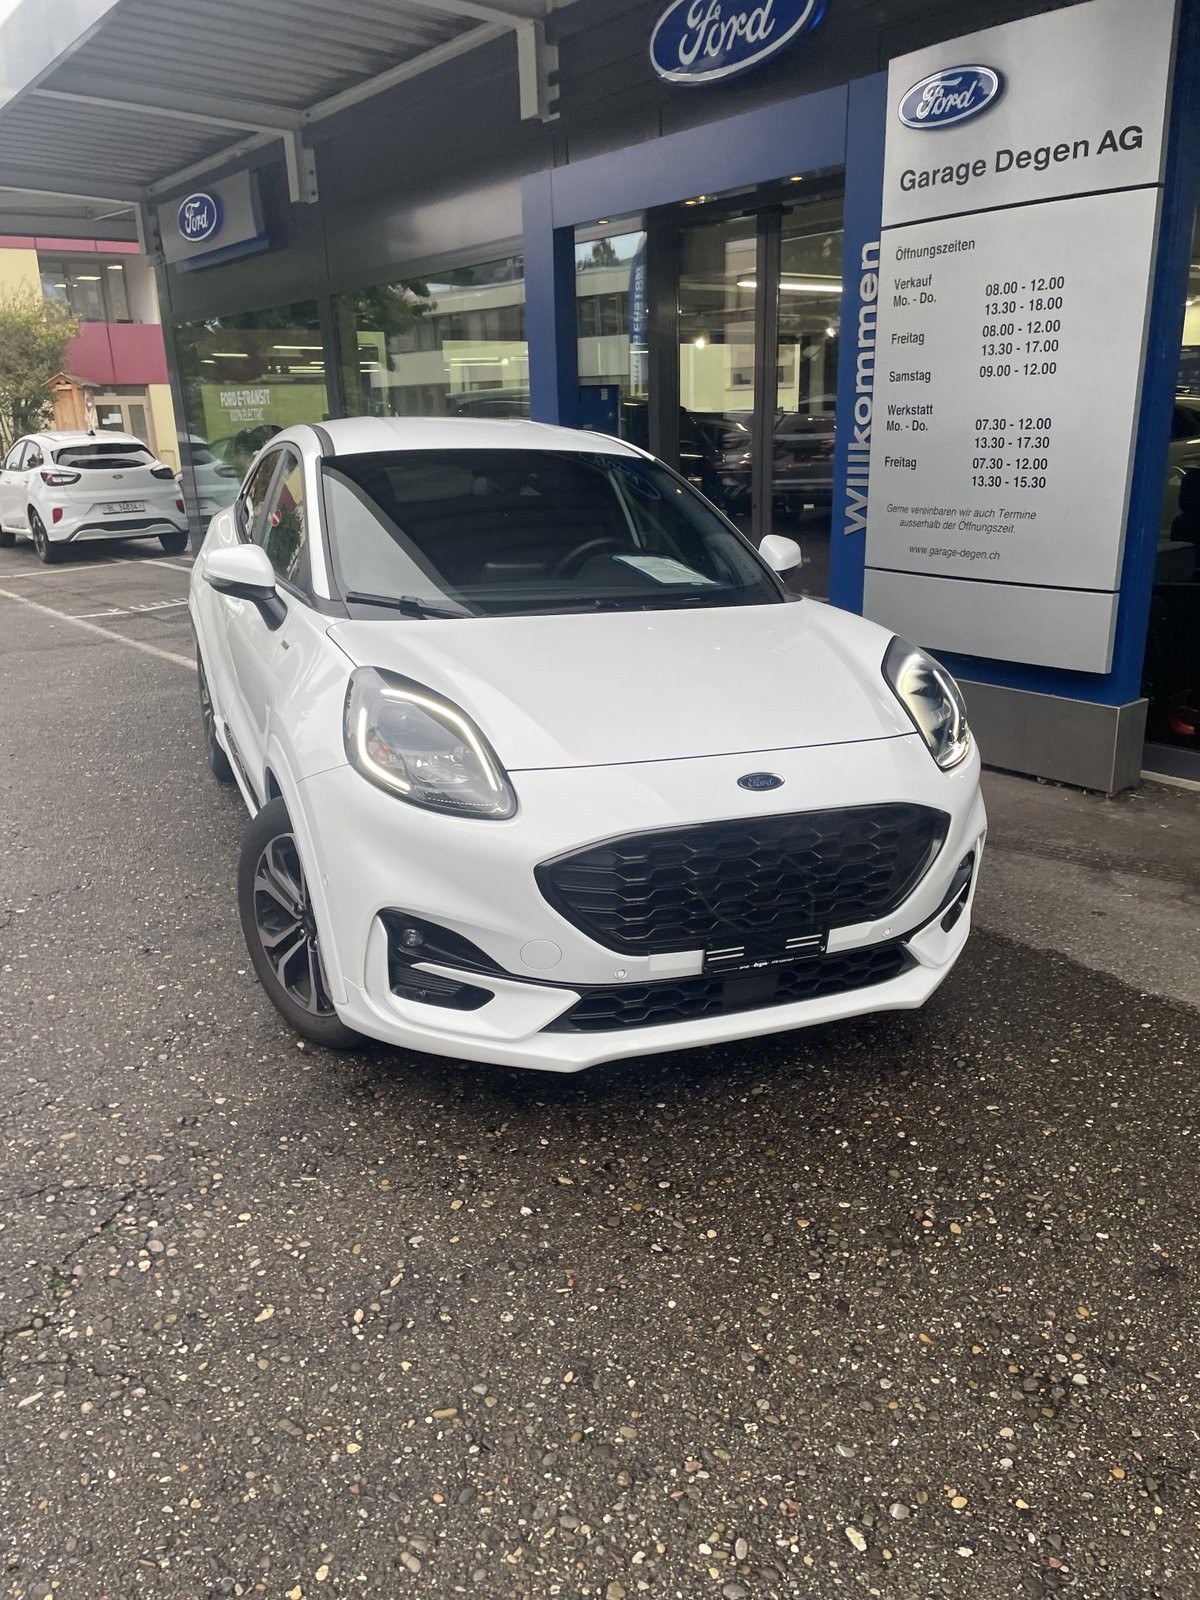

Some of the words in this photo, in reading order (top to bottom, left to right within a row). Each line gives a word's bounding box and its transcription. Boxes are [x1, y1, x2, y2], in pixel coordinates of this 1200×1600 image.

[678, 0, 776, 66] Ford
[916, 76, 978, 119] Ford
[900, 160, 986, 191] Garage
[995, 140, 1089, 173] Degen
[1096, 126, 1142, 155] AG
[185, 201, 209, 234] Ford
[896, 240, 975, 261] Öffnungszeiten
[894, 274, 932, 290] Verkauf
[986, 282, 1017, 296] 08.00
[1031, 276, 1064, 291] 12.00
[893, 295, 910, 307] Mo.
[920, 292, 936, 303] Do.
[985, 301, 1016, 315] 13.30
[1029, 297, 1062, 311] 18.00
[983, 323, 1014, 337] 08.00
[1027, 320, 1060, 334] 12.00
[891, 332, 924, 345] Freitag
[982, 343, 1012, 356] 13.30
[1026, 340, 1058, 353] 17.00
[890, 370, 931, 383] Samstag
[980, 365, 1010, 377] 09.00
[1024, 362, 1056, 375] 12.00
[888, 405, 933, 415] Werkstatt
[887, 421, 902, 431] Mo.
[912, 420, 928, 431] Do.
[976, 419, 1006, 430] 07.30
[1019, 418, 1051, 430] 12.00
[975, 437, 1004, 448] 13.30
[1017, 437, 1049, 448] 17.30
[885, 456, 916, 470] Freitag
[973, 458, 1003, 469] 07.30
[1016, 458, 1047, 470] 12.00
[972, 476, 1001, 487] 13.30
[1014, 476, 1046, 488] 15.30
[887, 504, 909, 513] Gerne
[911, 506, 956, 516] vereinbaren
[974, 509, 995, 518] auch
[999, 509, 1036, 519] Termine
[900, 520, 941, 528] ausserhalb
[943, 521, 956, 529] der
[910, 547, 1000, 560] www.garage-degen.ch
